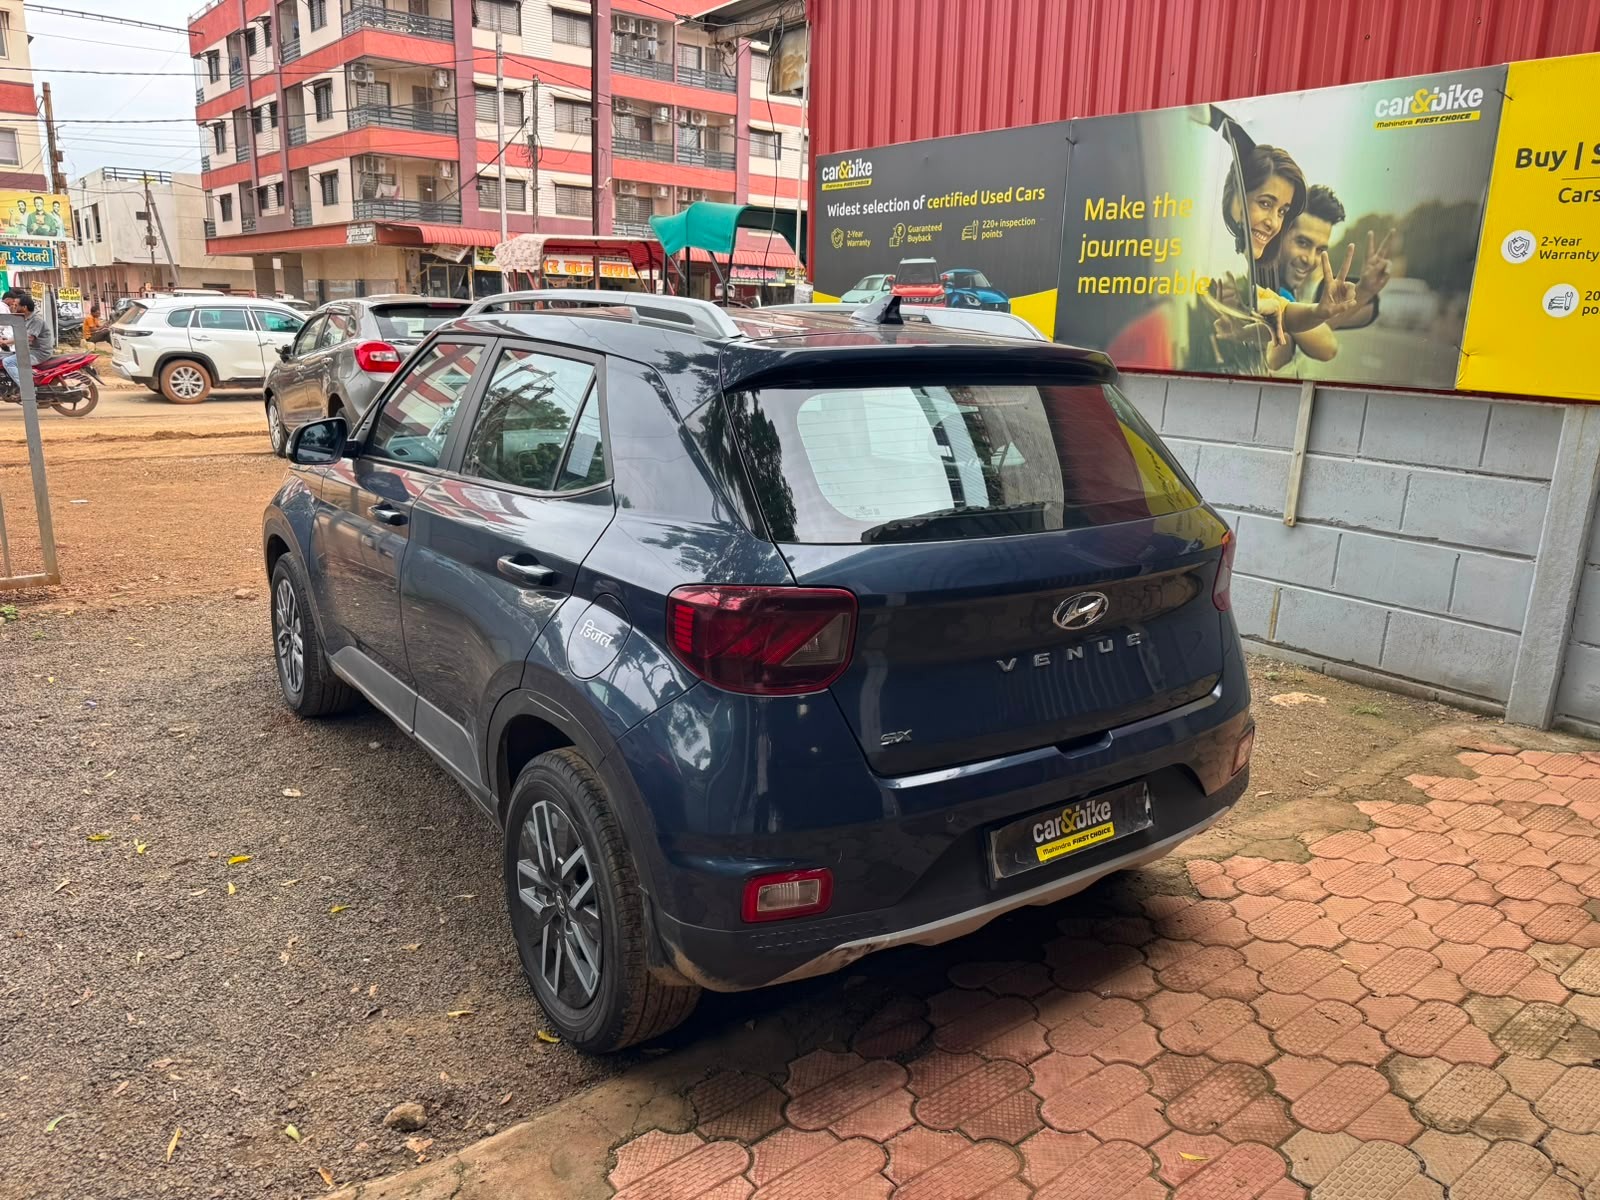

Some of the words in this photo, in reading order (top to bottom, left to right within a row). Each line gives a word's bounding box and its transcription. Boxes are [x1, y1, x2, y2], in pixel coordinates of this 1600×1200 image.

[1374, 83, 1484, 118] car&bike
[1376, 119, 1413, 129] Mahindra
[1414, 116, 1439, 125] FIRST
[1439, 113, 1472, 122] CHOICE
[1515, 147, 1567, 171] Buy
[822, 158, 873, 181] car&bike
[827, 202, 861, 217] Widest
[863, 199, 910, 215] selection
[913, 195, 926, 210] of
[927, 190, 977, 209] certified
[981, 188, 1012, 205] Used
[1015, 187, 1045, 202] Cars
[1558, 187, 1600, 204] Cars
[1084, 195, 1146, 221] Make
[1152, 192, 1194, 218] the
[907, 222, 943, 233] Guaranteed
[982, 219, 999, 229] 220+
[999, 217, 1036, 228] inspection
[847, 230, 864, 238] 2-Year
[907, 233, 932, 244] Buyback
[981, 229, 1003, 240] points
[1541, 236, 1582, 247] 2-Year
[846, 238, 871, 248] Warranty
[1078, 234, 1183, 264] journeys
[16, 248, 50, 263] स्टेशनरी
[1539, 249, 1600, 262] Warranty
[1077, 269, 1211, 295] memorable
[1582, 304, 1600, 317] po
[996, 632, 1141, 672] VENUE
[880, 729, 912, 746] SX
[1033, 800, 1112, 843] car&bike
[1042, 841, 1072, 856] Mahindra
[1072, 834, 1090, 846] FIRST
[1090, 826, 1112, 839] CHOICE
